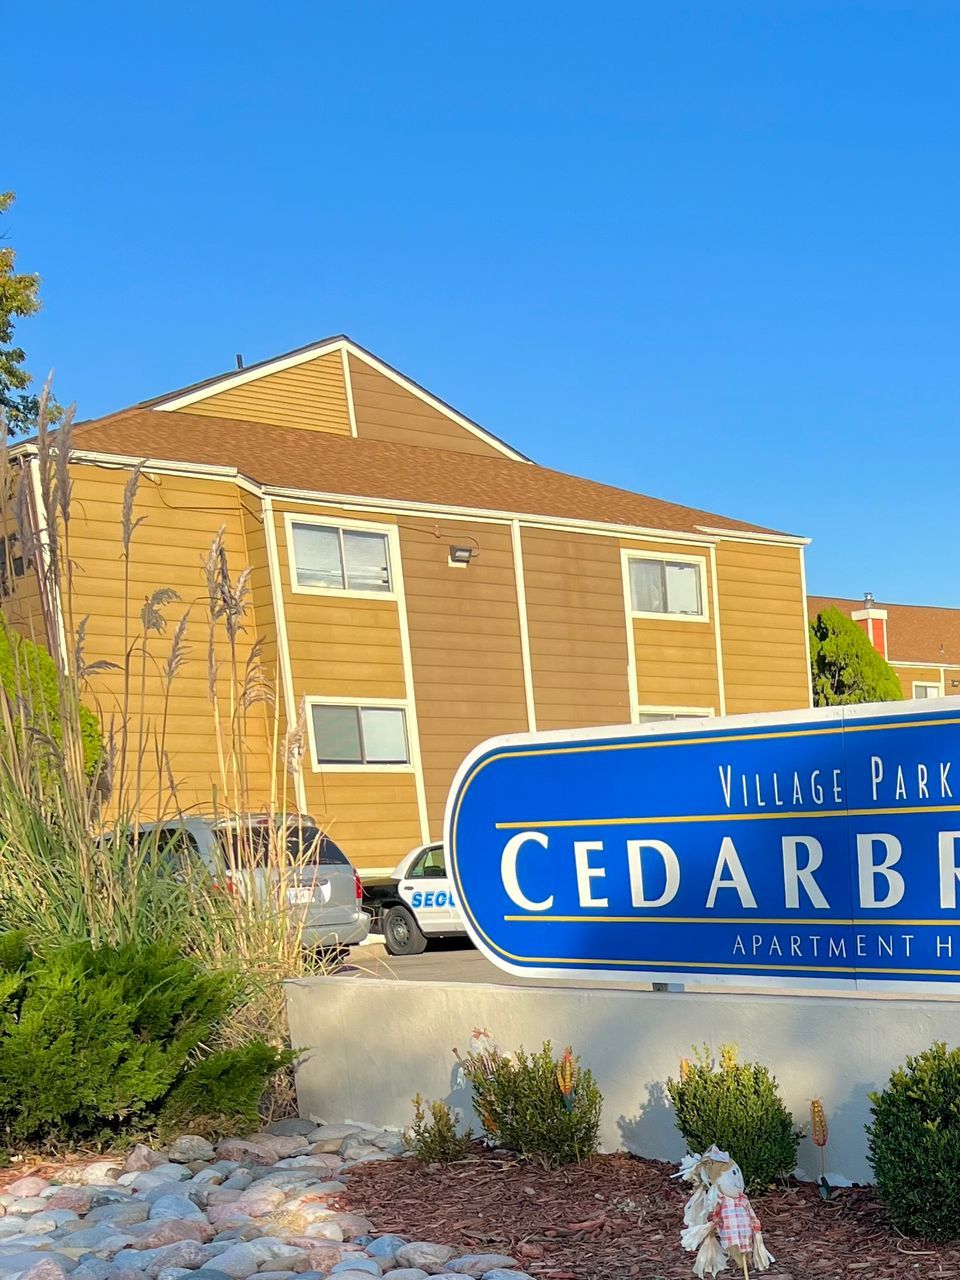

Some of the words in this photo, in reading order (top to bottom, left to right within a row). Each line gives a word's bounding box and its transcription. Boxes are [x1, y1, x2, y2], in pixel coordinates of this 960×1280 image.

[718, 765, 843, 808] VILLAGE
[871, 756, 953, 801] PARK
[732, 934, 914, 958] APARTMENT
